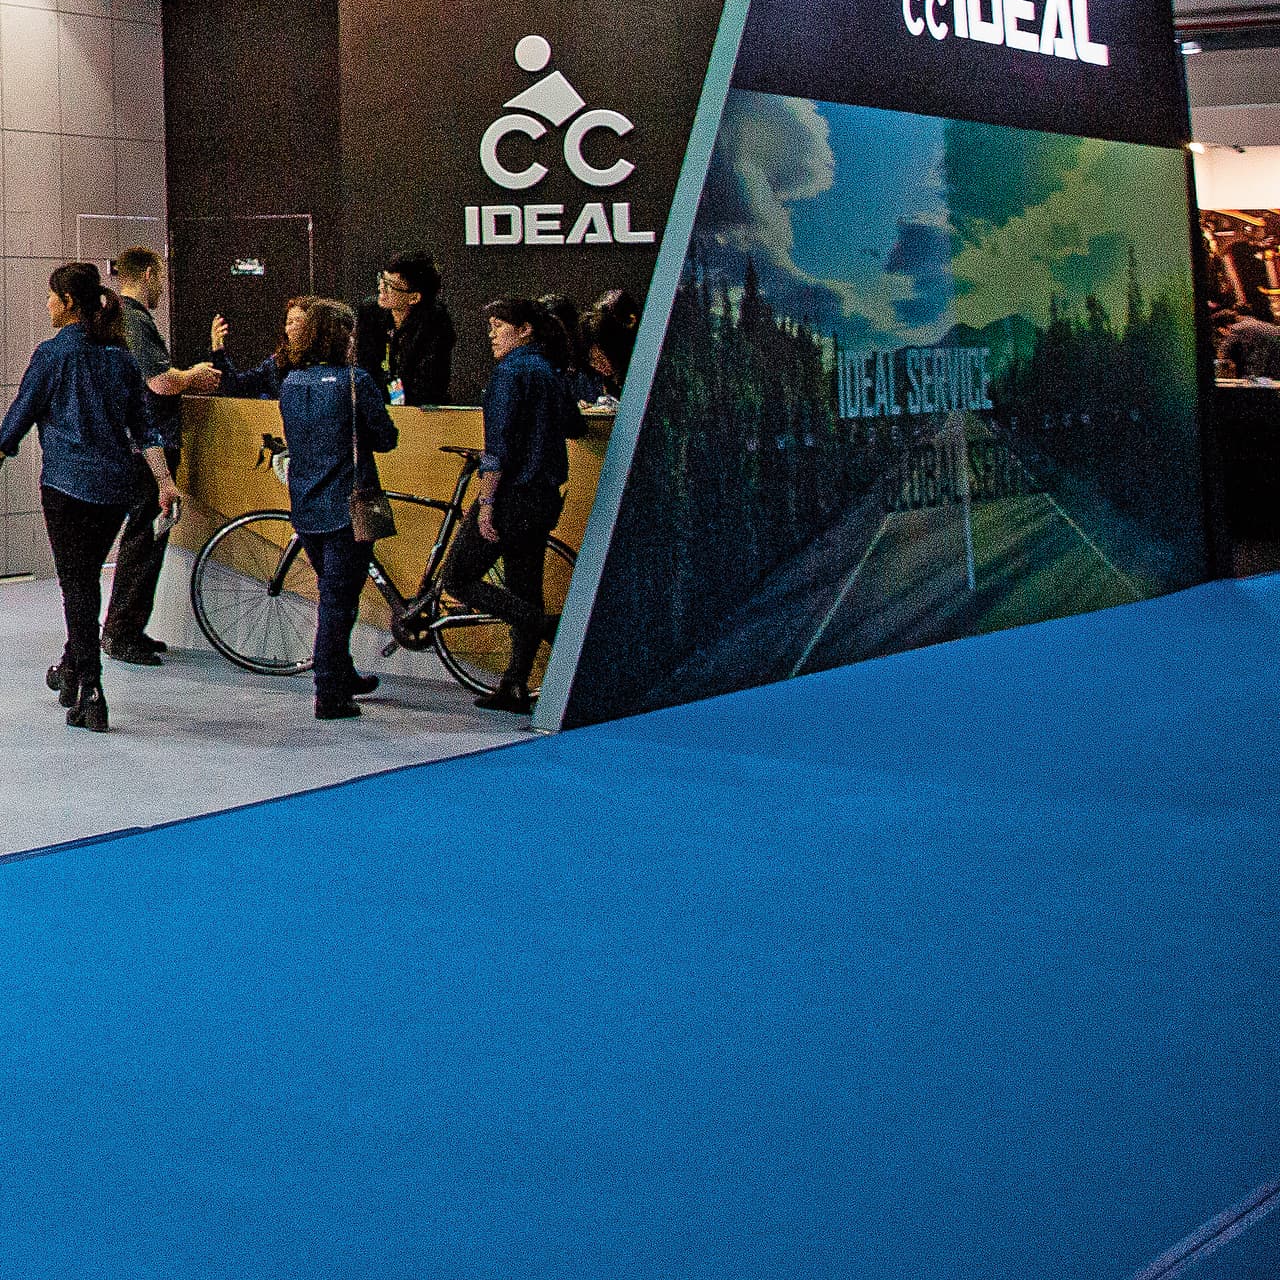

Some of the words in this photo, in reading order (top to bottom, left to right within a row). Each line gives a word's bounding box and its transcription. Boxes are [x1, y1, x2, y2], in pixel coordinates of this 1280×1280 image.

[464, 202, 656, 246] IDEAL
[837, 349, 901, 418] IDEAL
[907, 347, 993, 415] SERVICE
